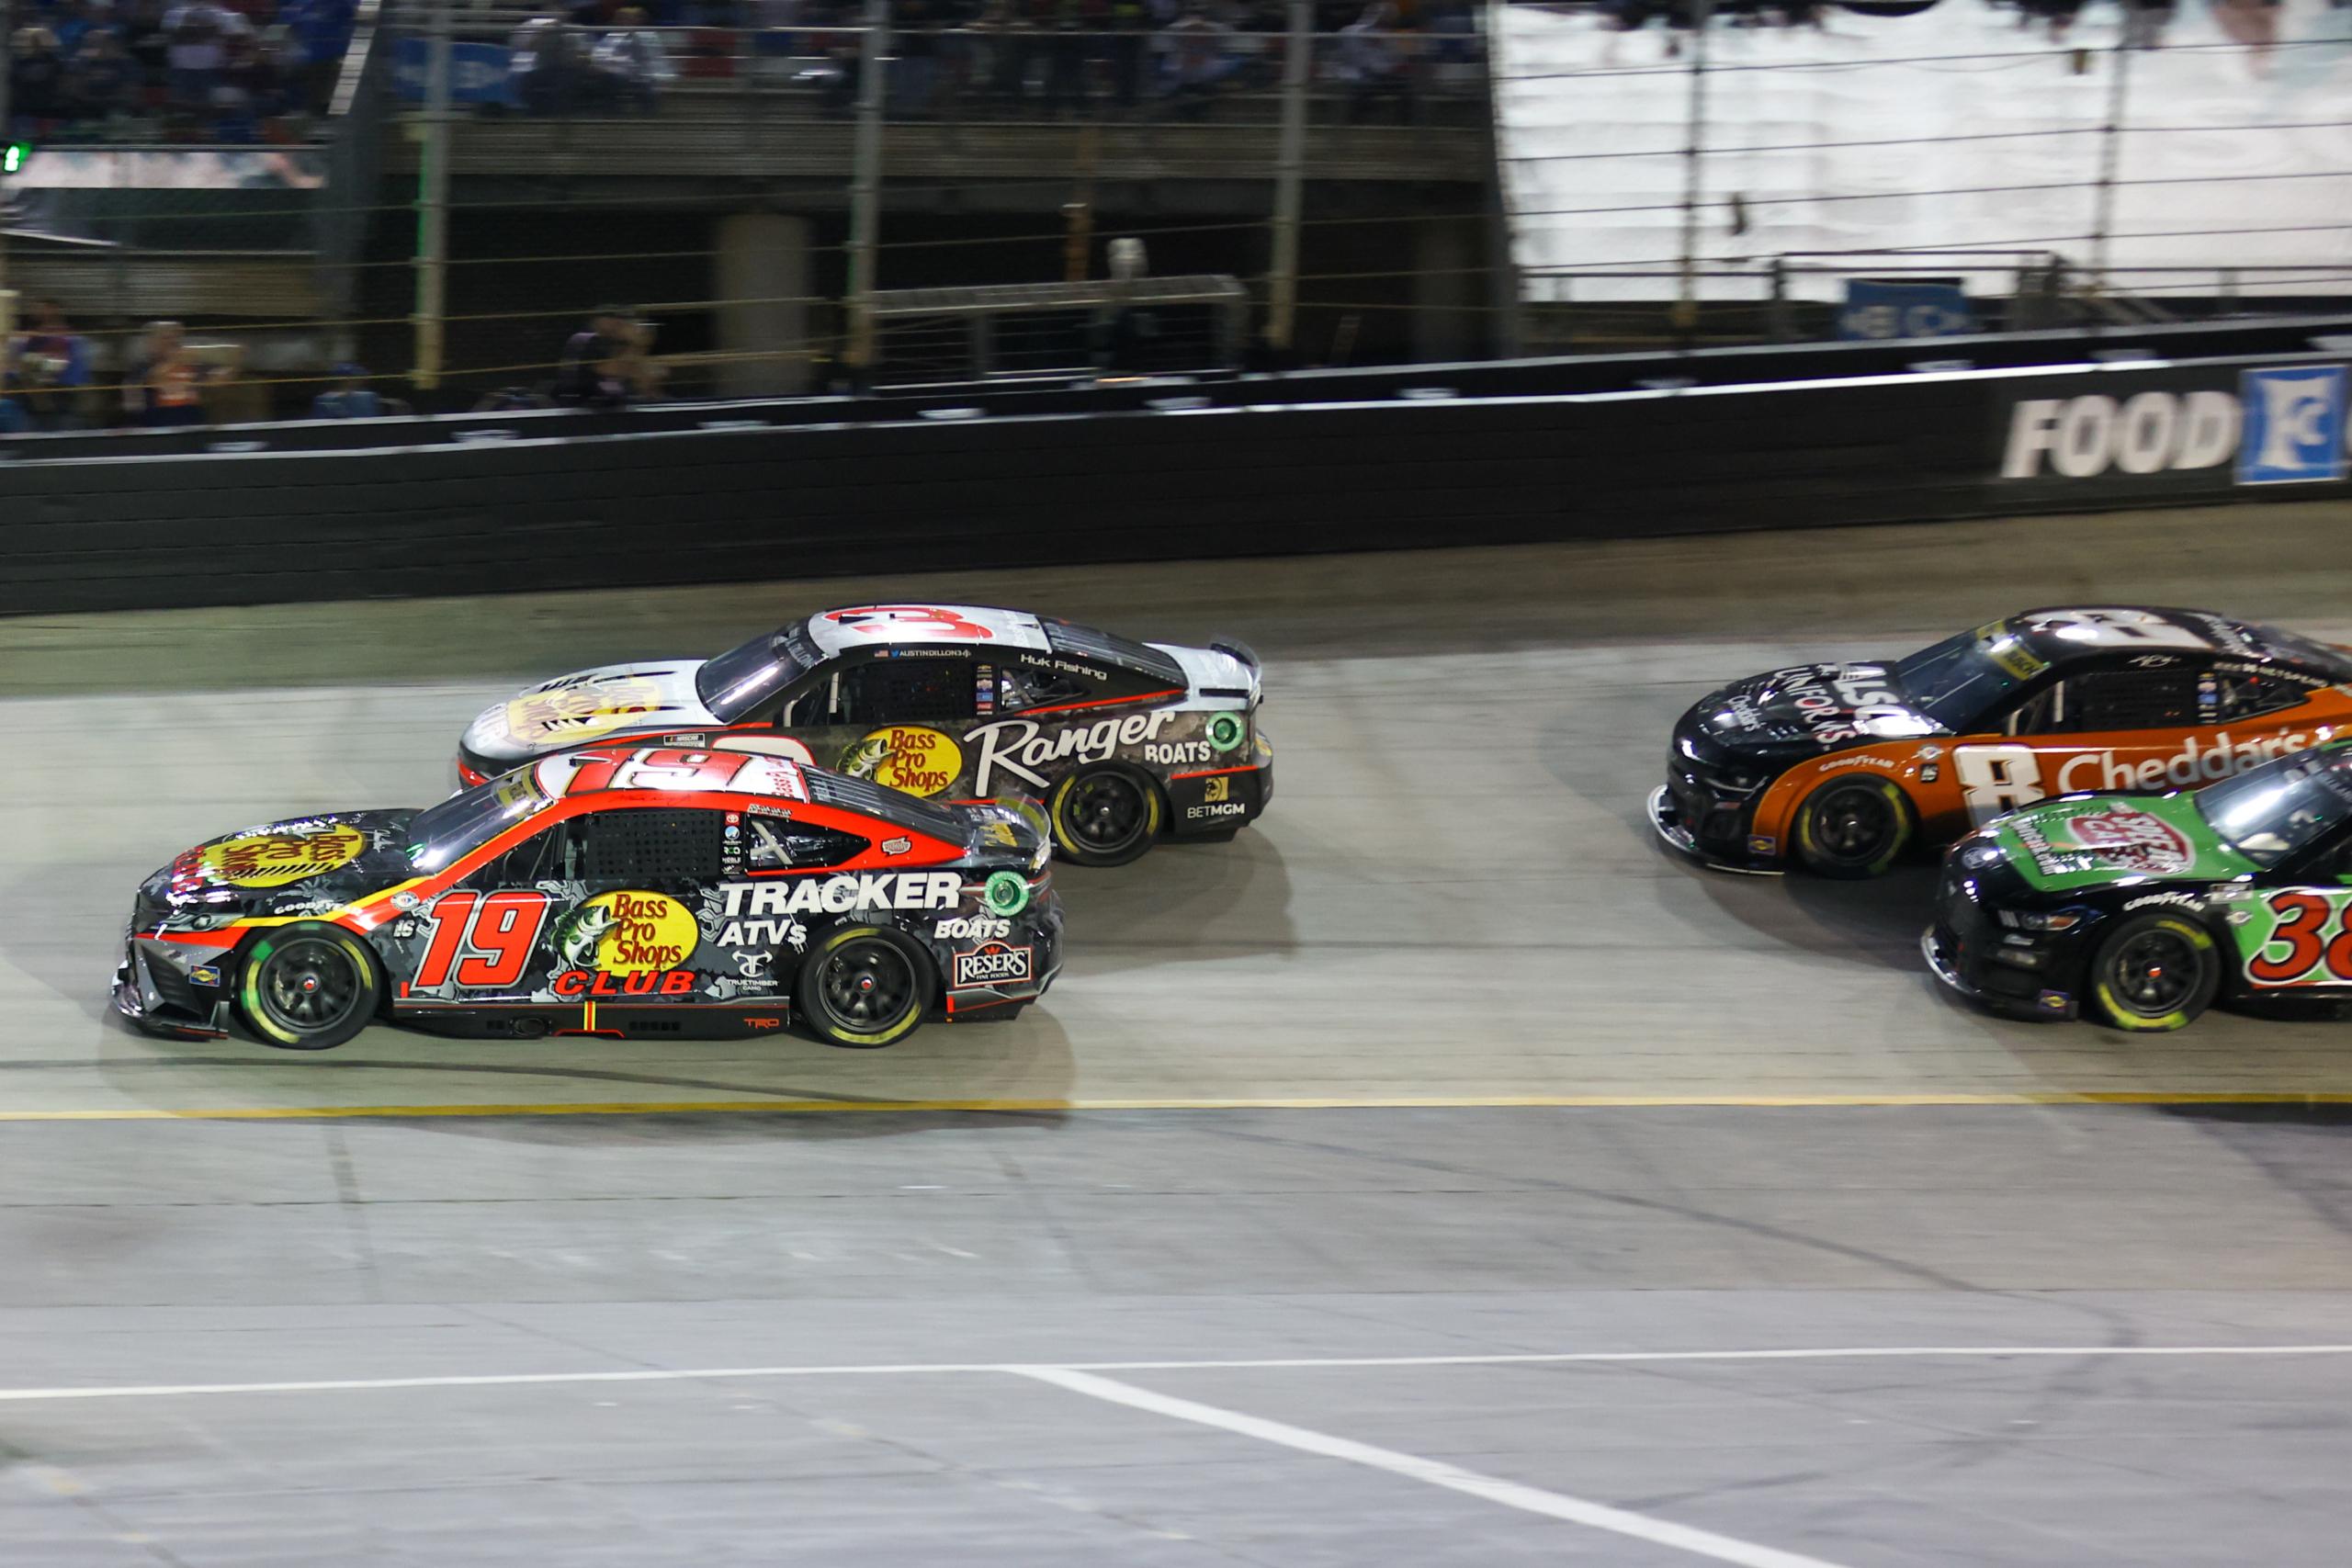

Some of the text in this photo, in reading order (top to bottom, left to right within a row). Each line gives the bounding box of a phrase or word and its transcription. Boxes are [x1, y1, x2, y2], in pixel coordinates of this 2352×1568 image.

[2001, 391, 2241, 478] FOOD
[1021, 653, 1107, 681] Huk Fishing
[888, 728, 936, 750] Bass
[1145, 740, 1212, 764] BOATS
[889, 749, 926, 769] Pro
[964, 710, 1176, 797] Ranger
[889, 767, 949, 793] Shops
[1952, 743, 2047, 830] 8
[1187, 803, 1246, 819] BETMGM
[309, 833, 359, 862] Bass
[612, 893, 668, 919] Bass
[718, 872, 962, 917] TRACKER
[410, 889, 552, 991] 19
[614, 919, 656, 942] Pro
[933, 918, 1012, 939] BOATS
[613, 941, 682, 970] Shops
[554, 970, 696, 996] CLUB
[727, 978, 778, 987] TRUETIMBER
